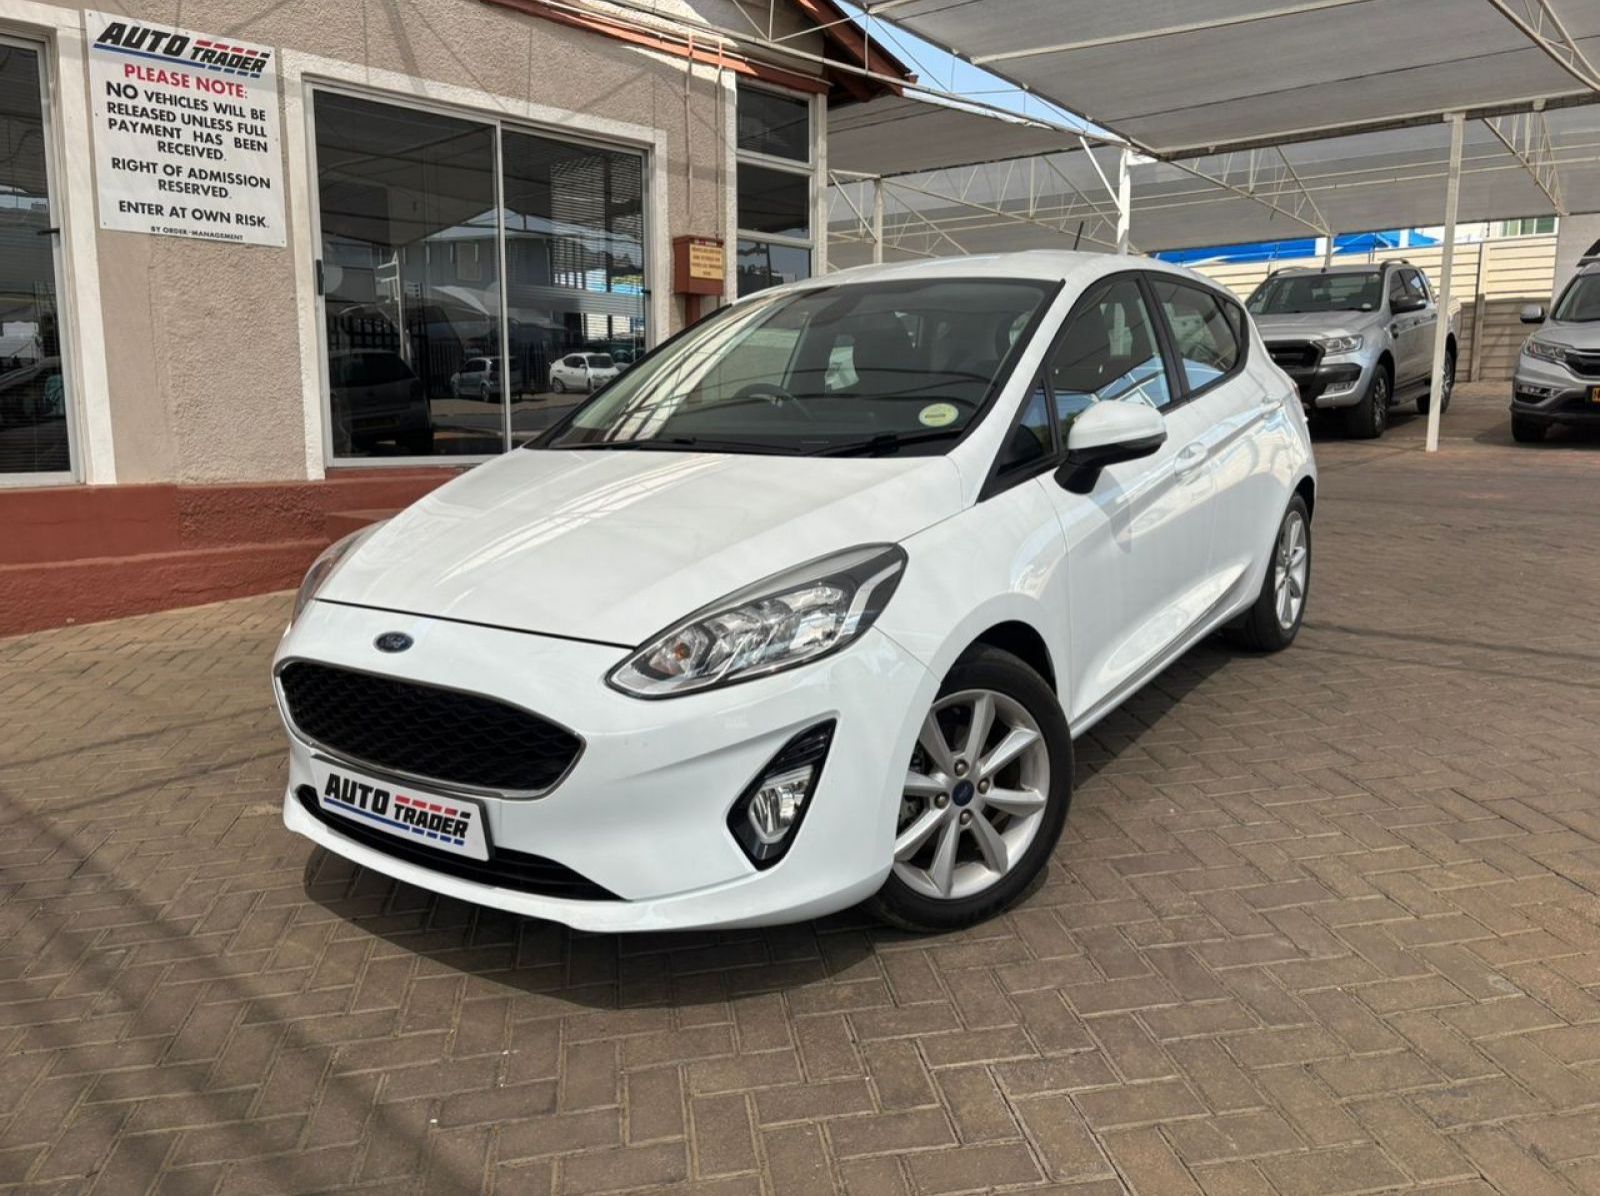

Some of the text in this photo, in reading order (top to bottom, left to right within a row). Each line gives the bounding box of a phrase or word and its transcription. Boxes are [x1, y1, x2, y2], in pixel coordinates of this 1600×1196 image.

[97, 22, 268, 73] AUTO TRADER
[124, 63, 248, 99] PLEASE NOTE:
[106, 81, 266, 122] NO VEHICLES WILL BE
[107, 101, 268, 138] RELEASED UNLESS FULL
[108, 118, 268, 153] PAYMENT HAS BEEN
[157, 141, 227, 162] RECEIVED.
[111, 157, 271, 189] RIGHT OF ADMISSION
[119, 200, 164, 216] ENTER
[169, 206, 187, 219] AT
[191, 208, 231, 224] OWN
[324, 773, 470, 839] AUTO TRADER
